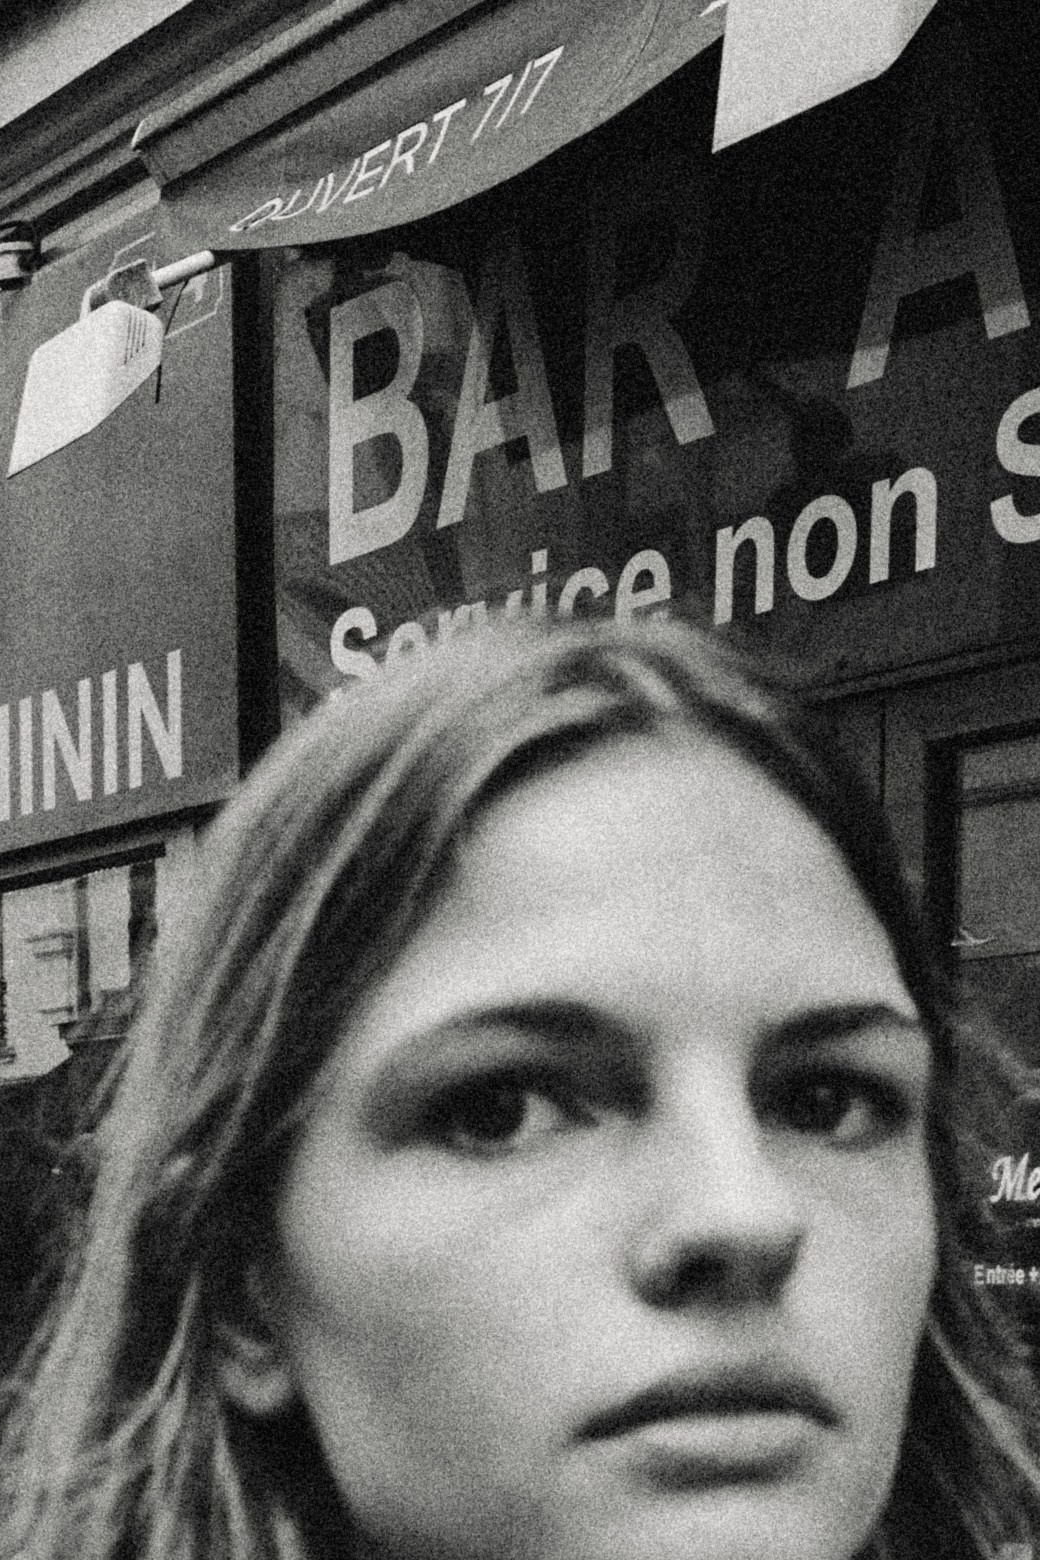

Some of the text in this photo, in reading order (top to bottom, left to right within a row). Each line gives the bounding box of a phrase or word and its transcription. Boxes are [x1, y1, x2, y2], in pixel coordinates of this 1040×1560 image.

[229, 45, 564, 232] OUVERT 7/7
[328, 150, 716, 567] BAR
[715, 464, 938, 626] non
